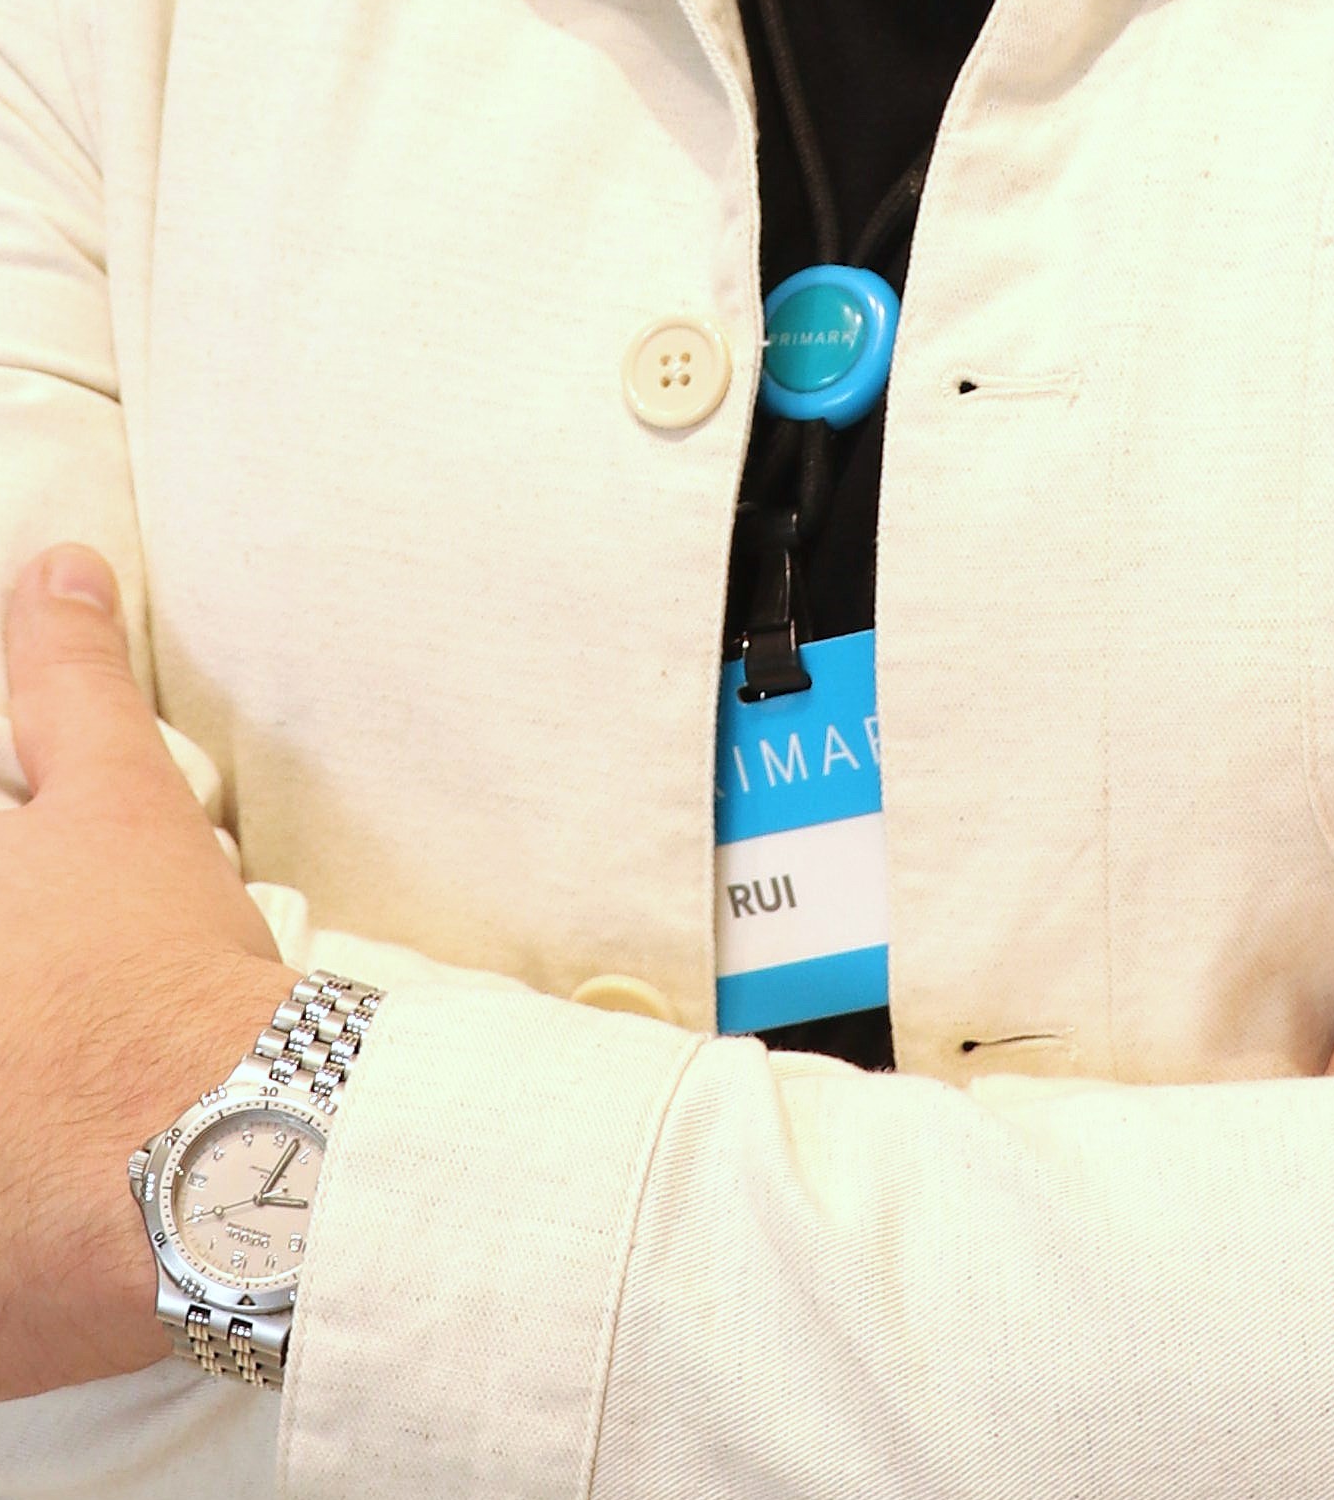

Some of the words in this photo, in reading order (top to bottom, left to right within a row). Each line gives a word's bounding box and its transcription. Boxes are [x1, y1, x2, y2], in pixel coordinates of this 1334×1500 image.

[727, 874, 797, 918] RUI
[259, 1086, 278, 1097] 30
[153, 1231, 168, 1249] 10
